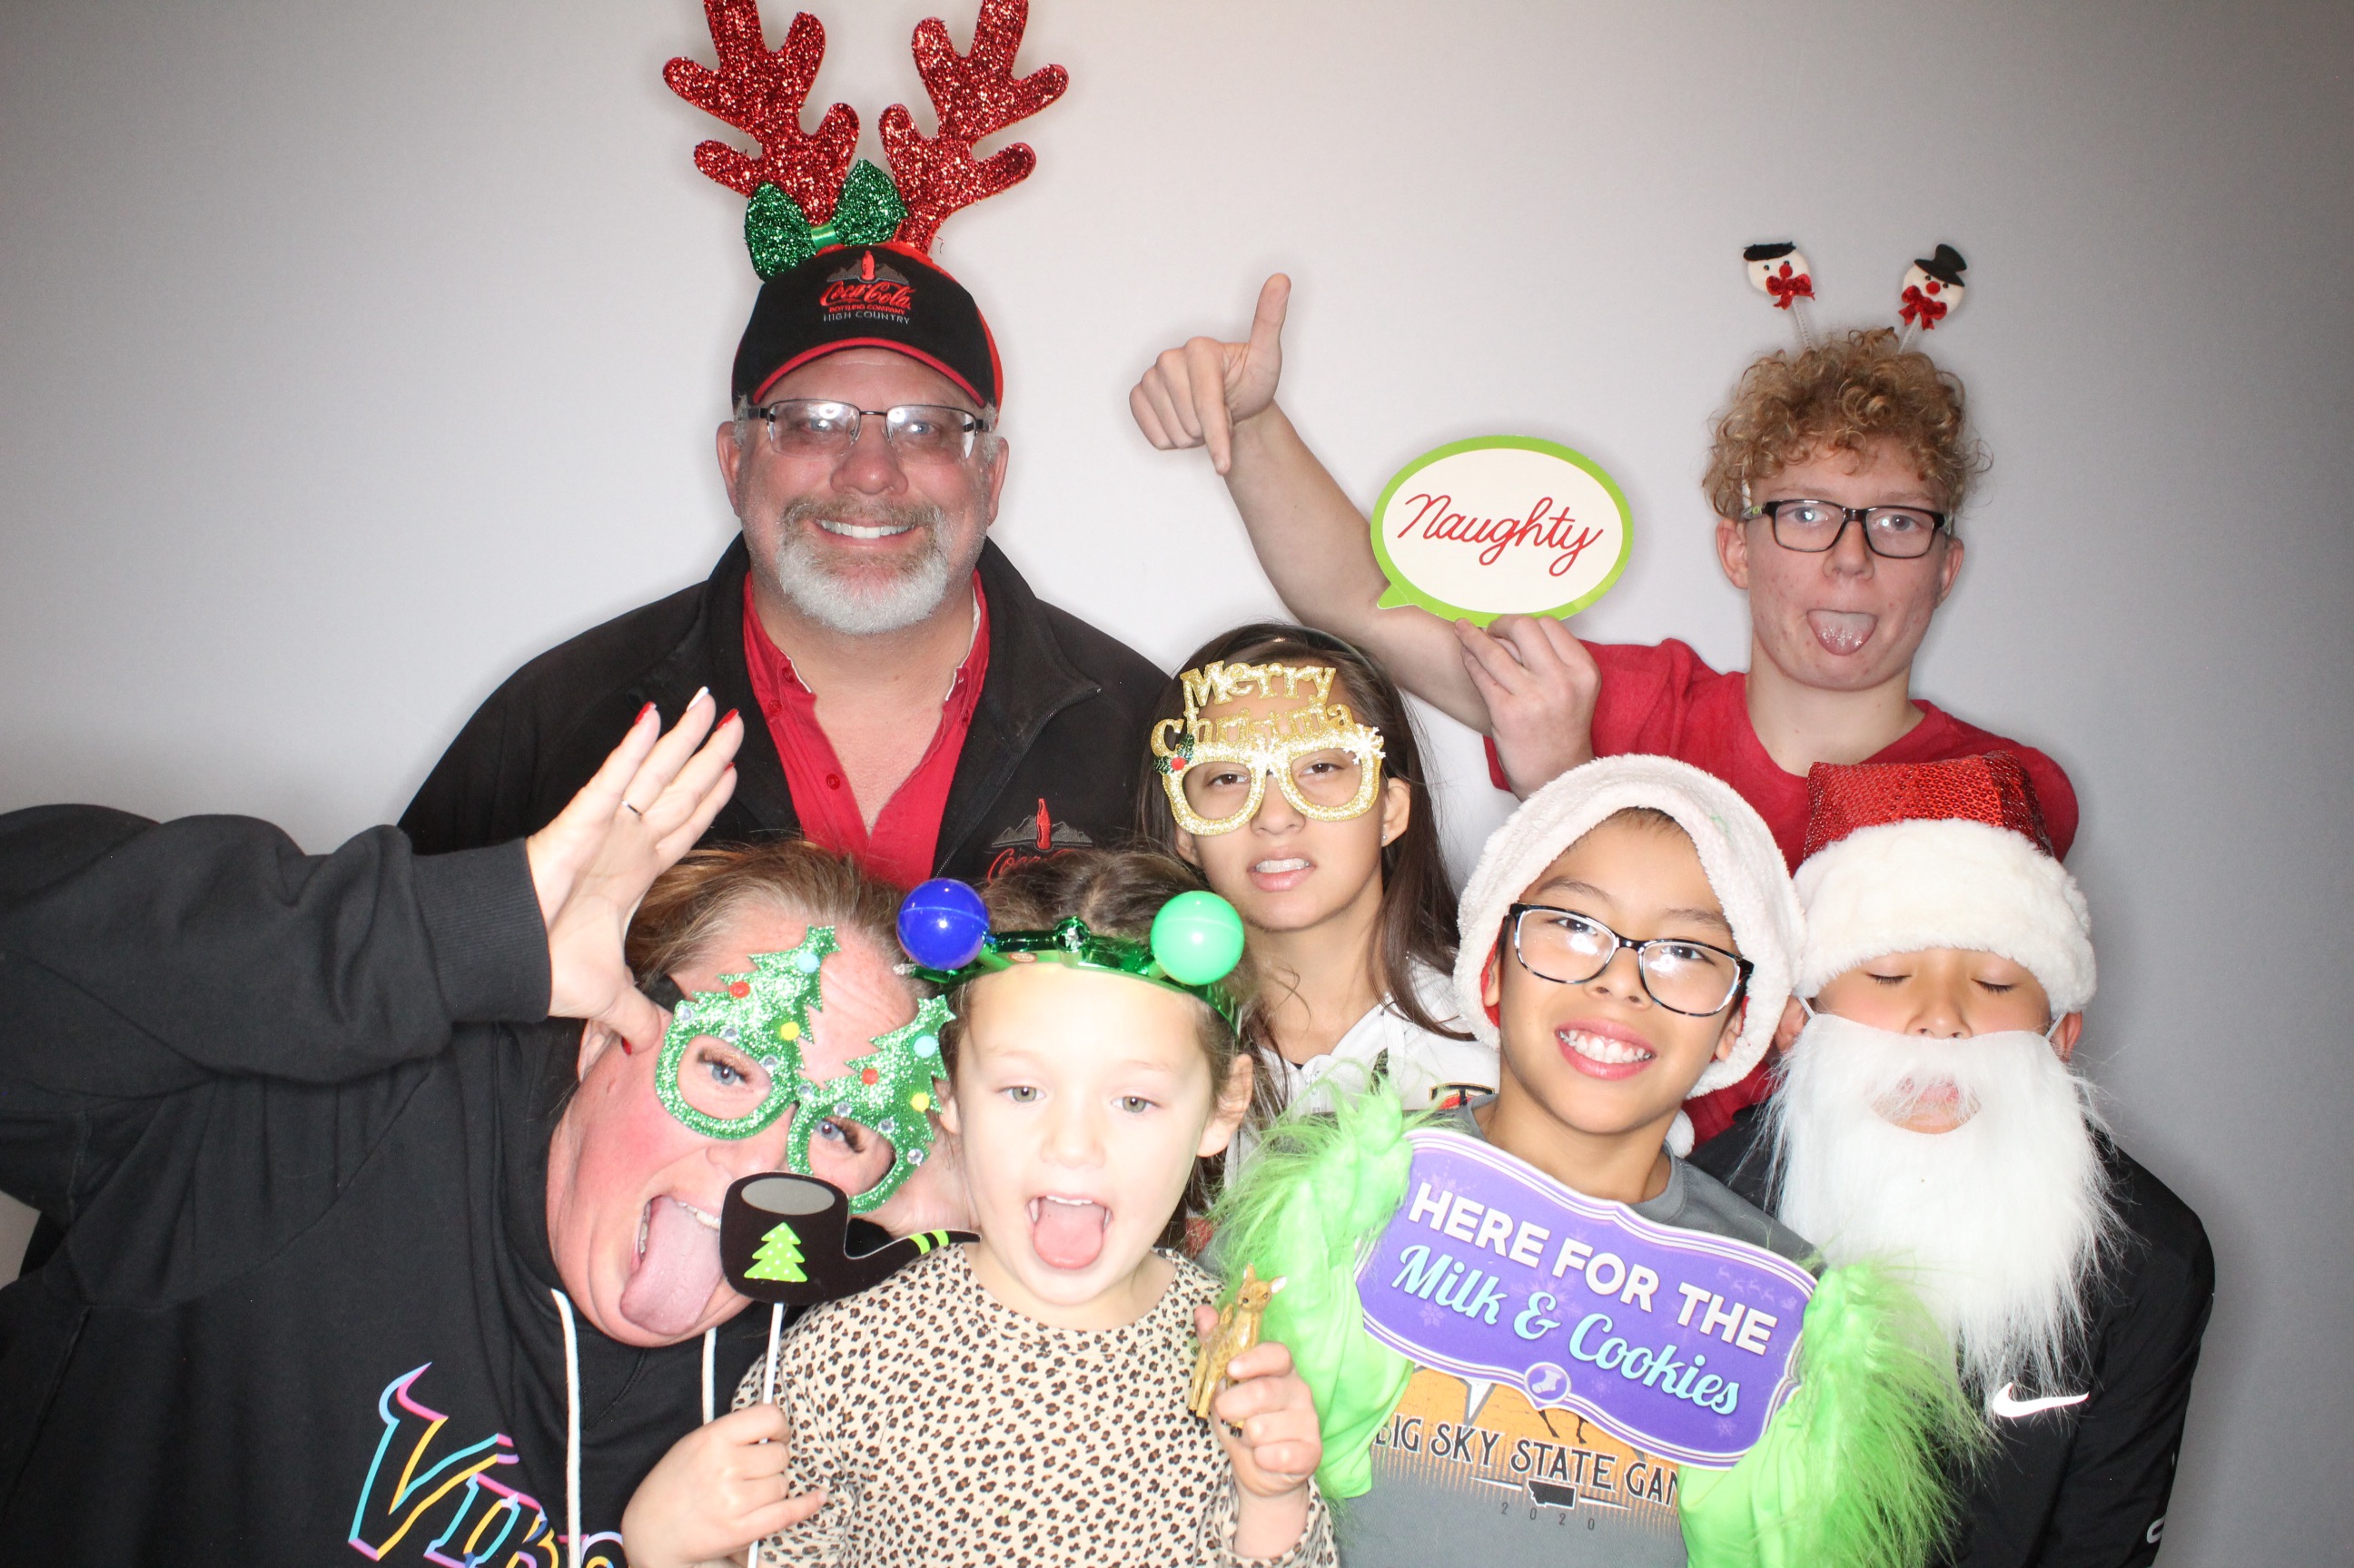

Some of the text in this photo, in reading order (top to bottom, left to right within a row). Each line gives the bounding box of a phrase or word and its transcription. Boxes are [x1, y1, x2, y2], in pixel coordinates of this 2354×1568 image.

[819, 280, 916, 310] Coca-Cola
[823, 311, 910, 325] HIGH COUNTRY
[867, 304, 905, 315] COMPANY
[1397, 493, 1605, 577] Naughty
[1179, 660, 1337, 713] Merry
[1151, 701, 1383, 758] Christma
[1409, 1182, 1778, 1356] HERE FOR THE
[1391, 1245, 1740, 1415] Milk & Cookies
[1429, 1422, 1506, 1468] SKY
[1509, 1438, 1617, 1493] STATE
